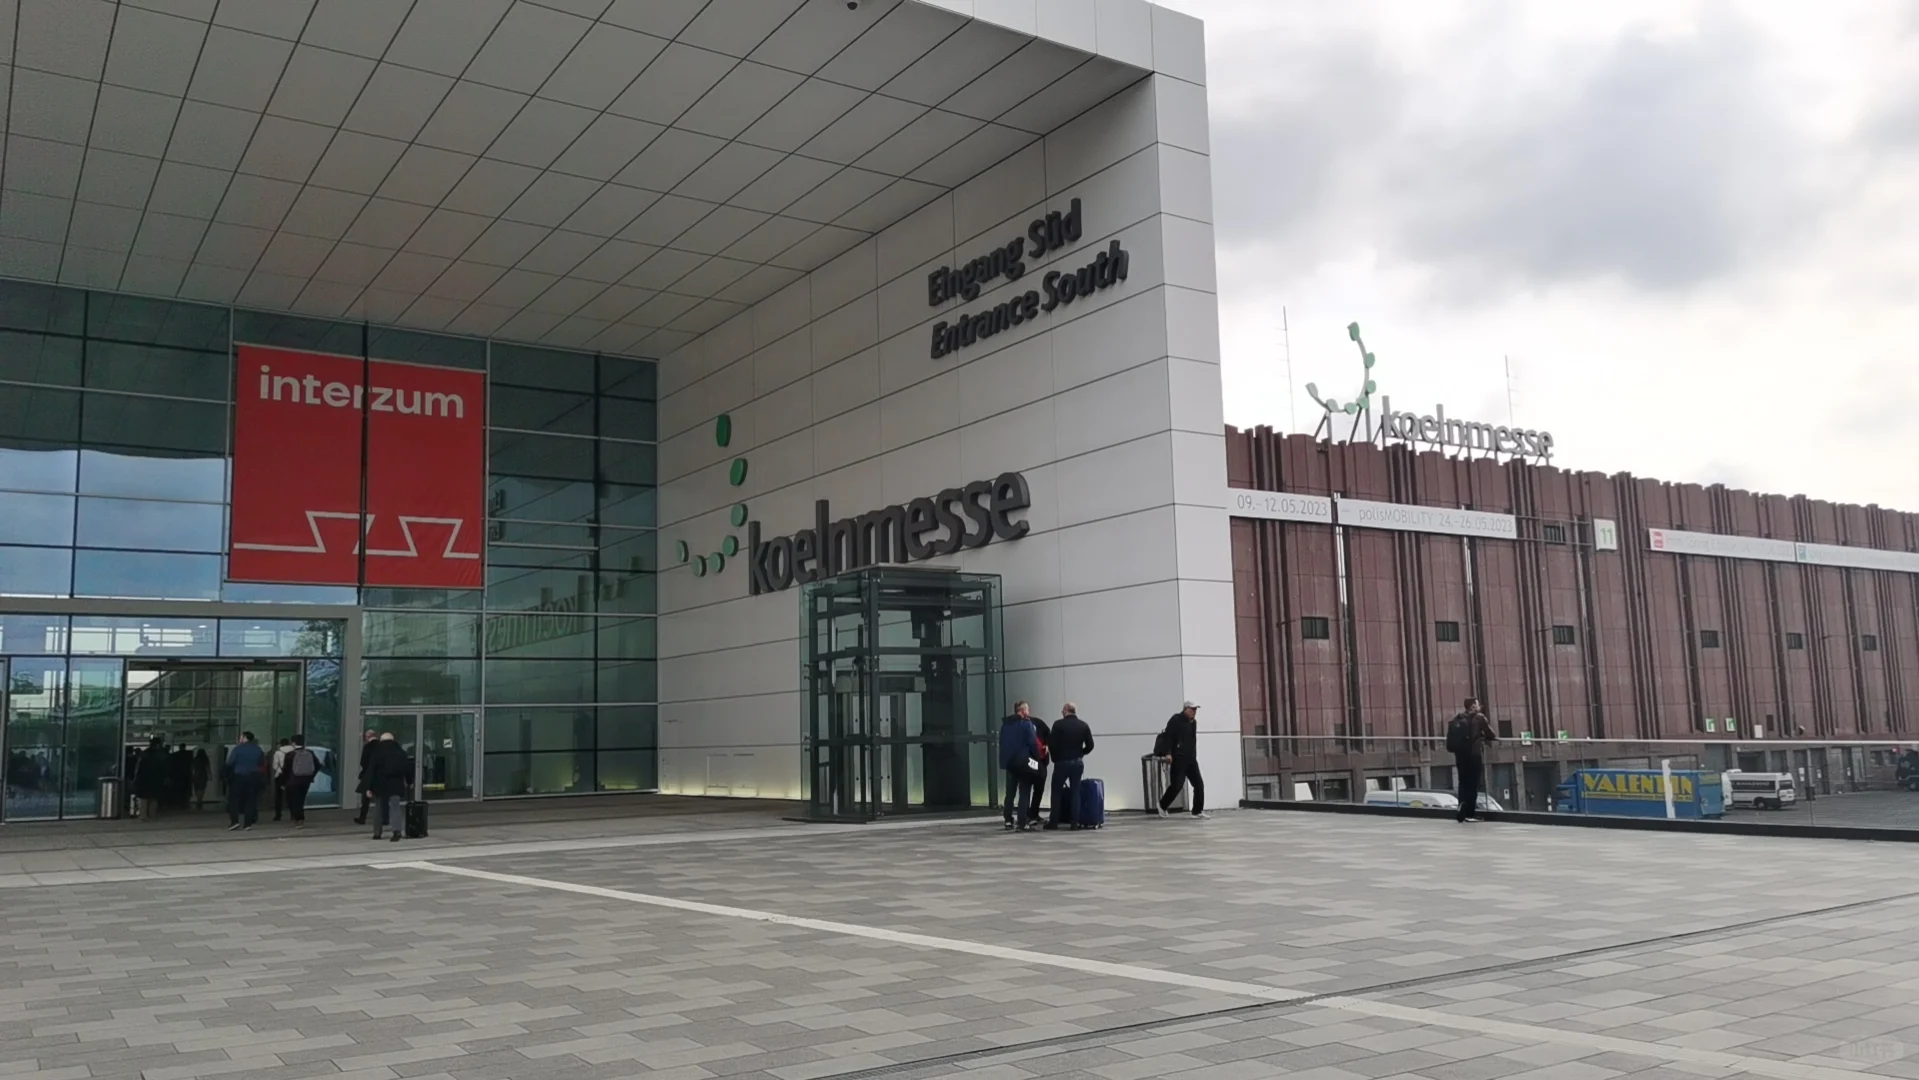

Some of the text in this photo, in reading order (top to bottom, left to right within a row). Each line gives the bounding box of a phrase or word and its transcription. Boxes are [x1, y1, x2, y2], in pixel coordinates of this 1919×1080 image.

[928, 198, 1083, 307] Eingang Süd
[931, 239, 1129, 360] Entrance South
[259, 365, 465, 420] interzum
[1383, 395, 1554, 459] koelnmesse
[748, 471, 1031, 595] koelnmesse
[1599, 527, 1614, 546] 11
